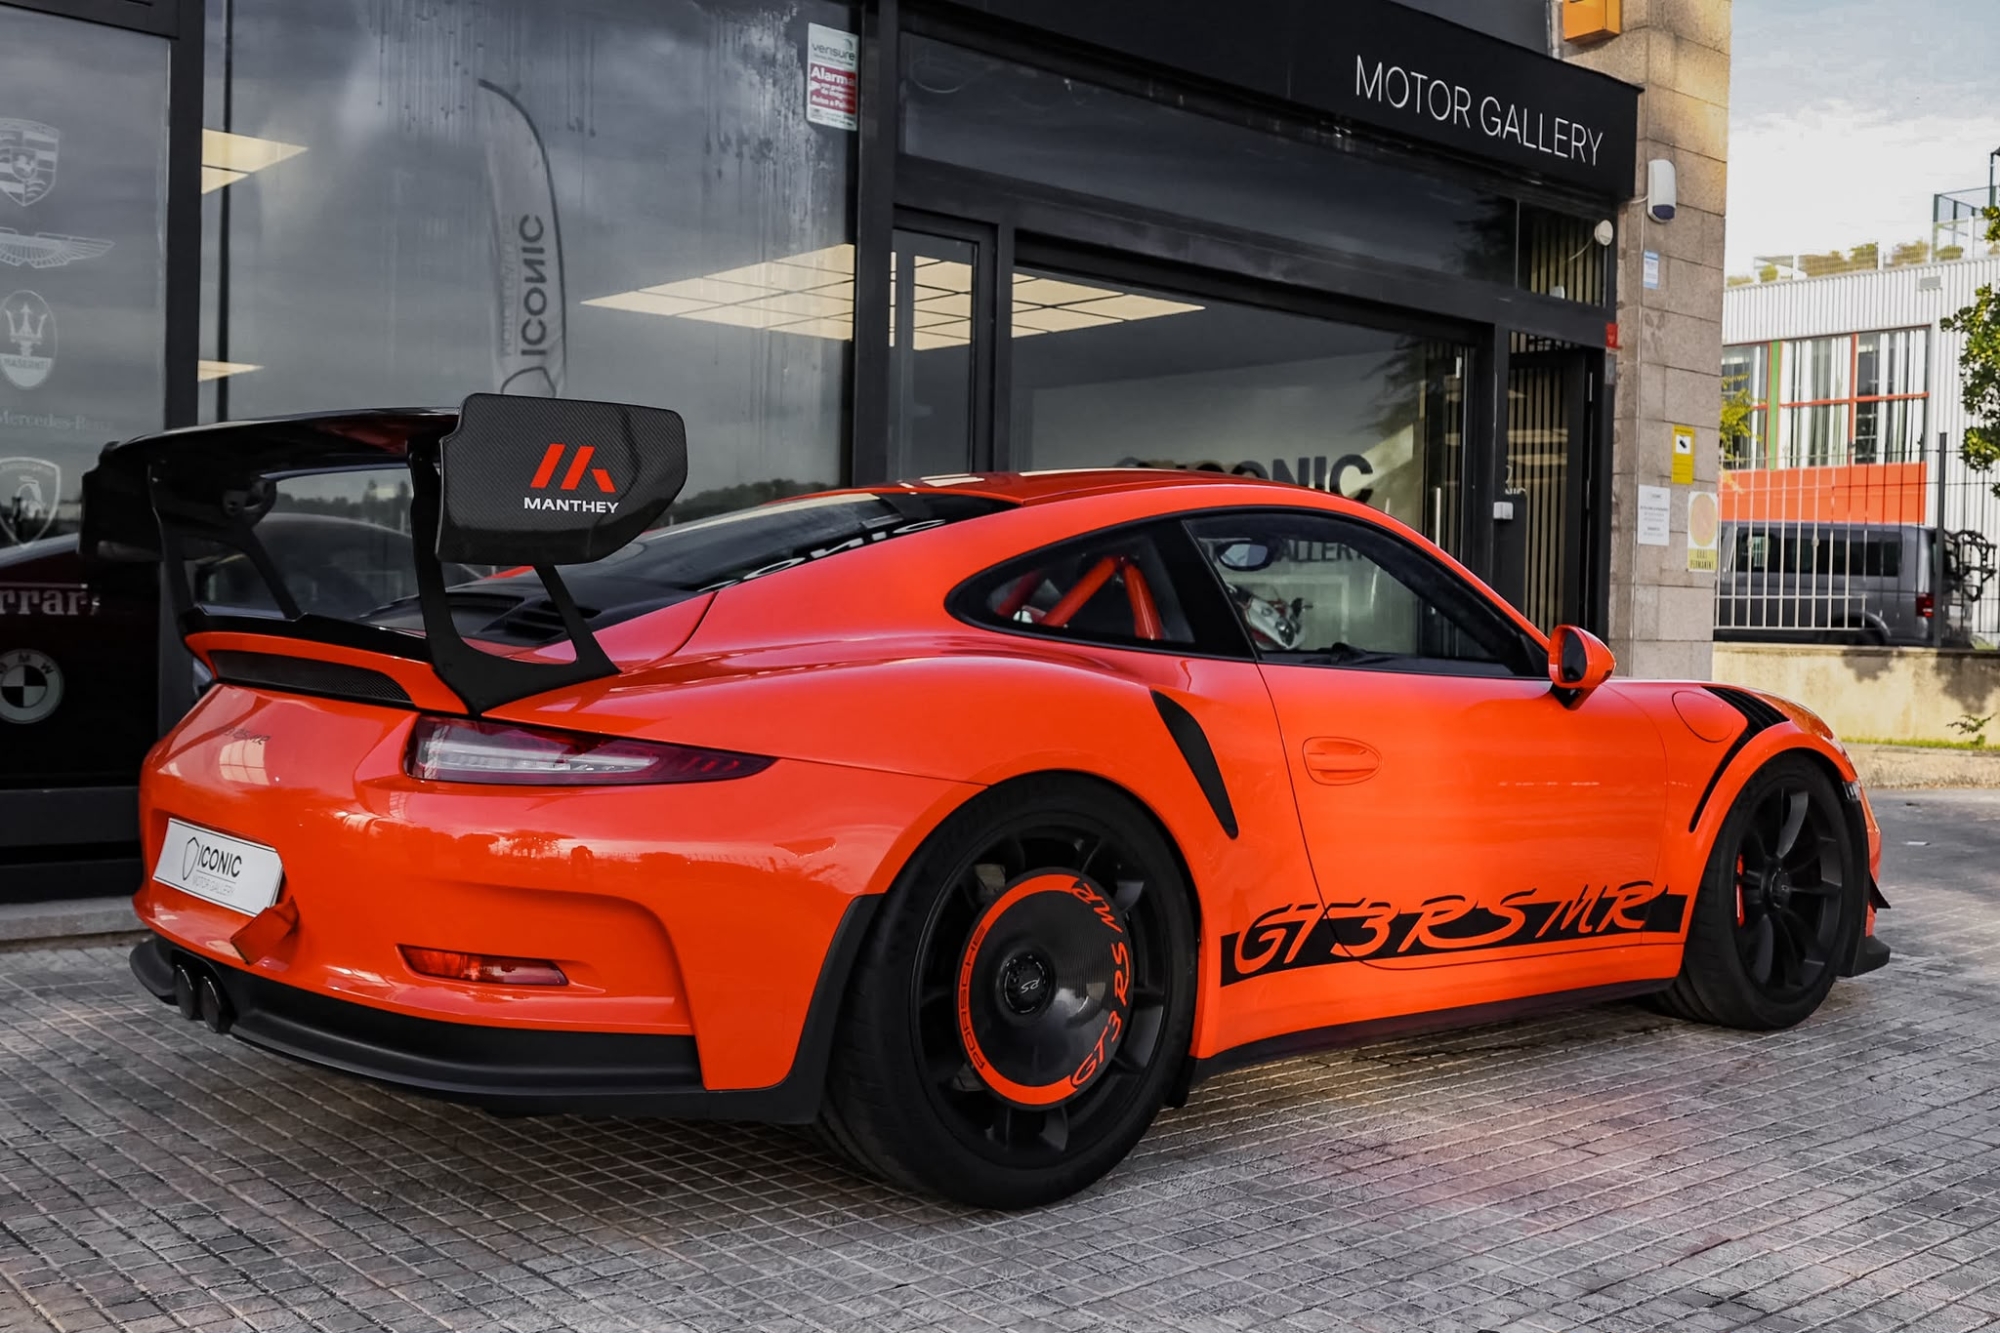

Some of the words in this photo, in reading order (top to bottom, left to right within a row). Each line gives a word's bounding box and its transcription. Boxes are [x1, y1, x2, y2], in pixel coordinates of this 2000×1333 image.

[1356, 55, 1471, 129] MOTOR
[1480, 96, 1603, 166] GALLERY
[524, 497, 619, 514] MANTHEY
[197, 844, 243, 878] ICONIC
[1234, 897, 1401, 974] GT3
[958, 925, 987, 1070] PORSCHE
[1071, 1011, 1122, 1086] GT3
[1111, 942, 1131, 1007] RS
